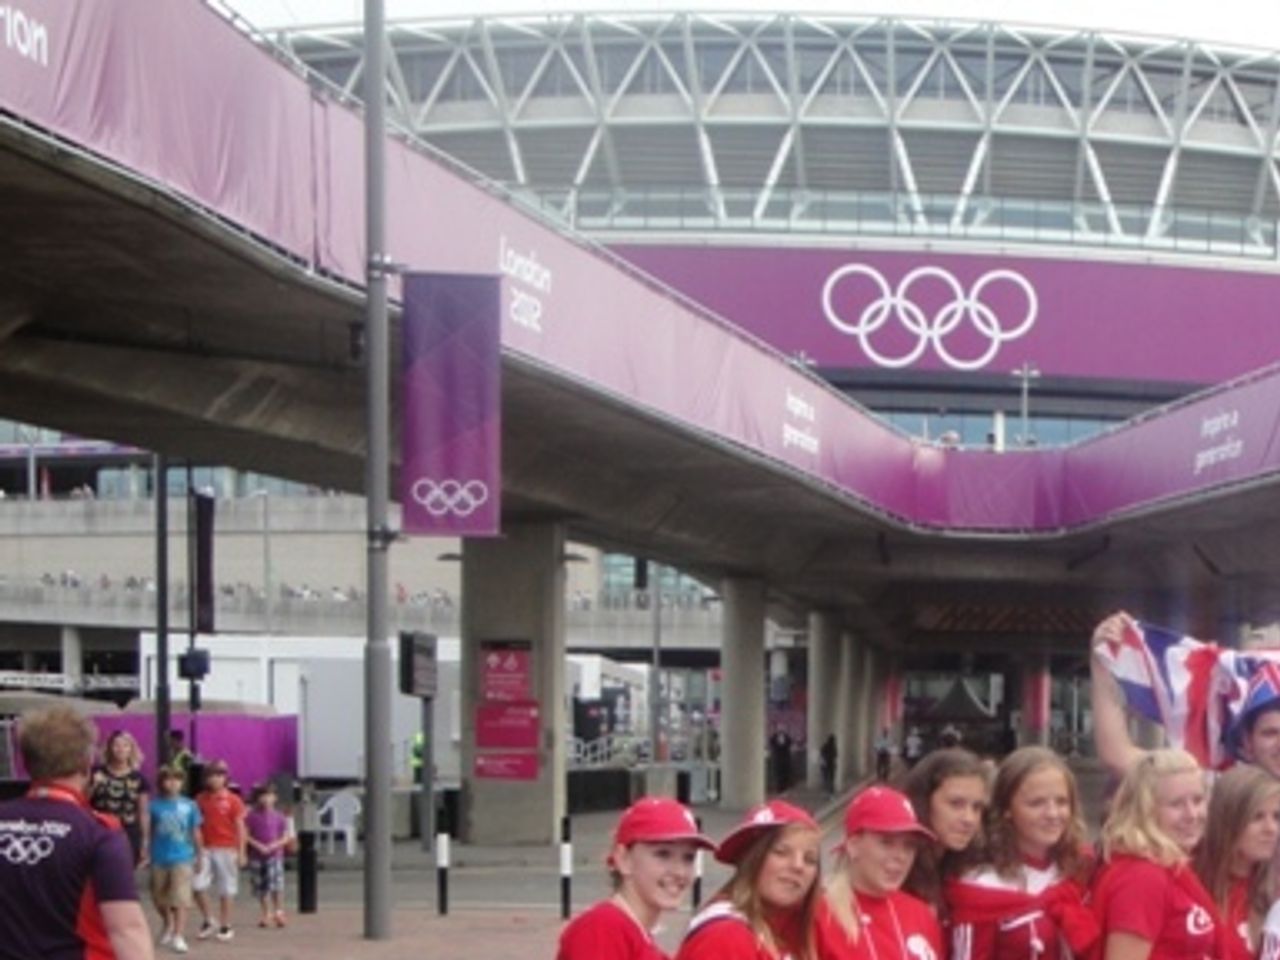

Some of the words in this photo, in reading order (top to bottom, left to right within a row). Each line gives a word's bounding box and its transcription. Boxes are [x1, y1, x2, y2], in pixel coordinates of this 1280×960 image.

[0, 5, 49, 67] ion
[499, 236, 552, 294] London
[509, 286, 542, 333] 2012
